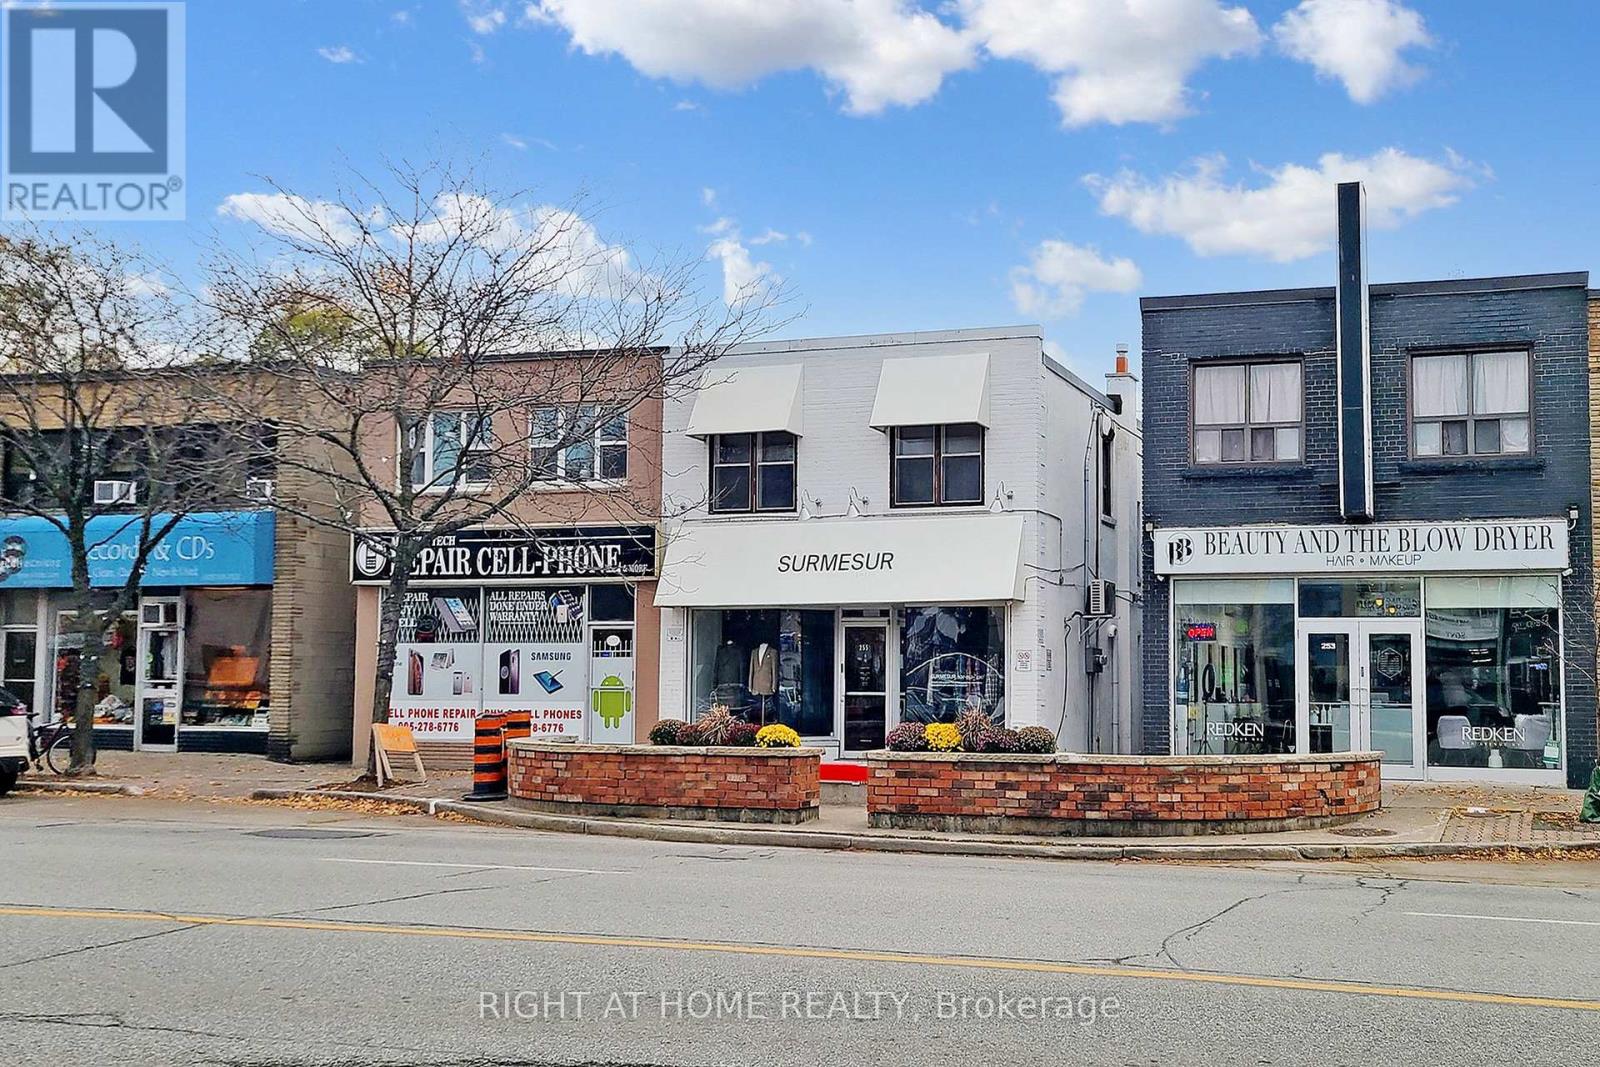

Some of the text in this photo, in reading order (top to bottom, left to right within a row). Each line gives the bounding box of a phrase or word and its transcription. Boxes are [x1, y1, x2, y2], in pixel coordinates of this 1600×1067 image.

[1205, 525, 1554, 555] BEAUTY AND THE BLOW DRYER
[154, 540, 171, 561] &
[176, 535, 215, 560] CDs
[389, 547, 472, 576] PAIR
[477, 544, 621, 575] CELL-PHONE
[777, 552, 894, 573] SURMESUR
[1326, 554, 1422, 566] HAIR MAKEUP
[490, 591, 546, 601] ALL REPAIRS
[489, 601, 548, 611] DONE UNDER
[398, 617, 418, 627] ELL
[1187, 627, 1214, 638] OPEN
[530, 652, 572, 661] SAMSUNG
[388, 708, 405, 719] ELL
[407, 708, 440, 719] PHONE
[442, 708, 476, 719] REPAIR
[543, 709, 582, 719] PHONES
[1206, 722, 1264, 737] REDKEN
[1461, 726, 1525, 742] REDKEN
